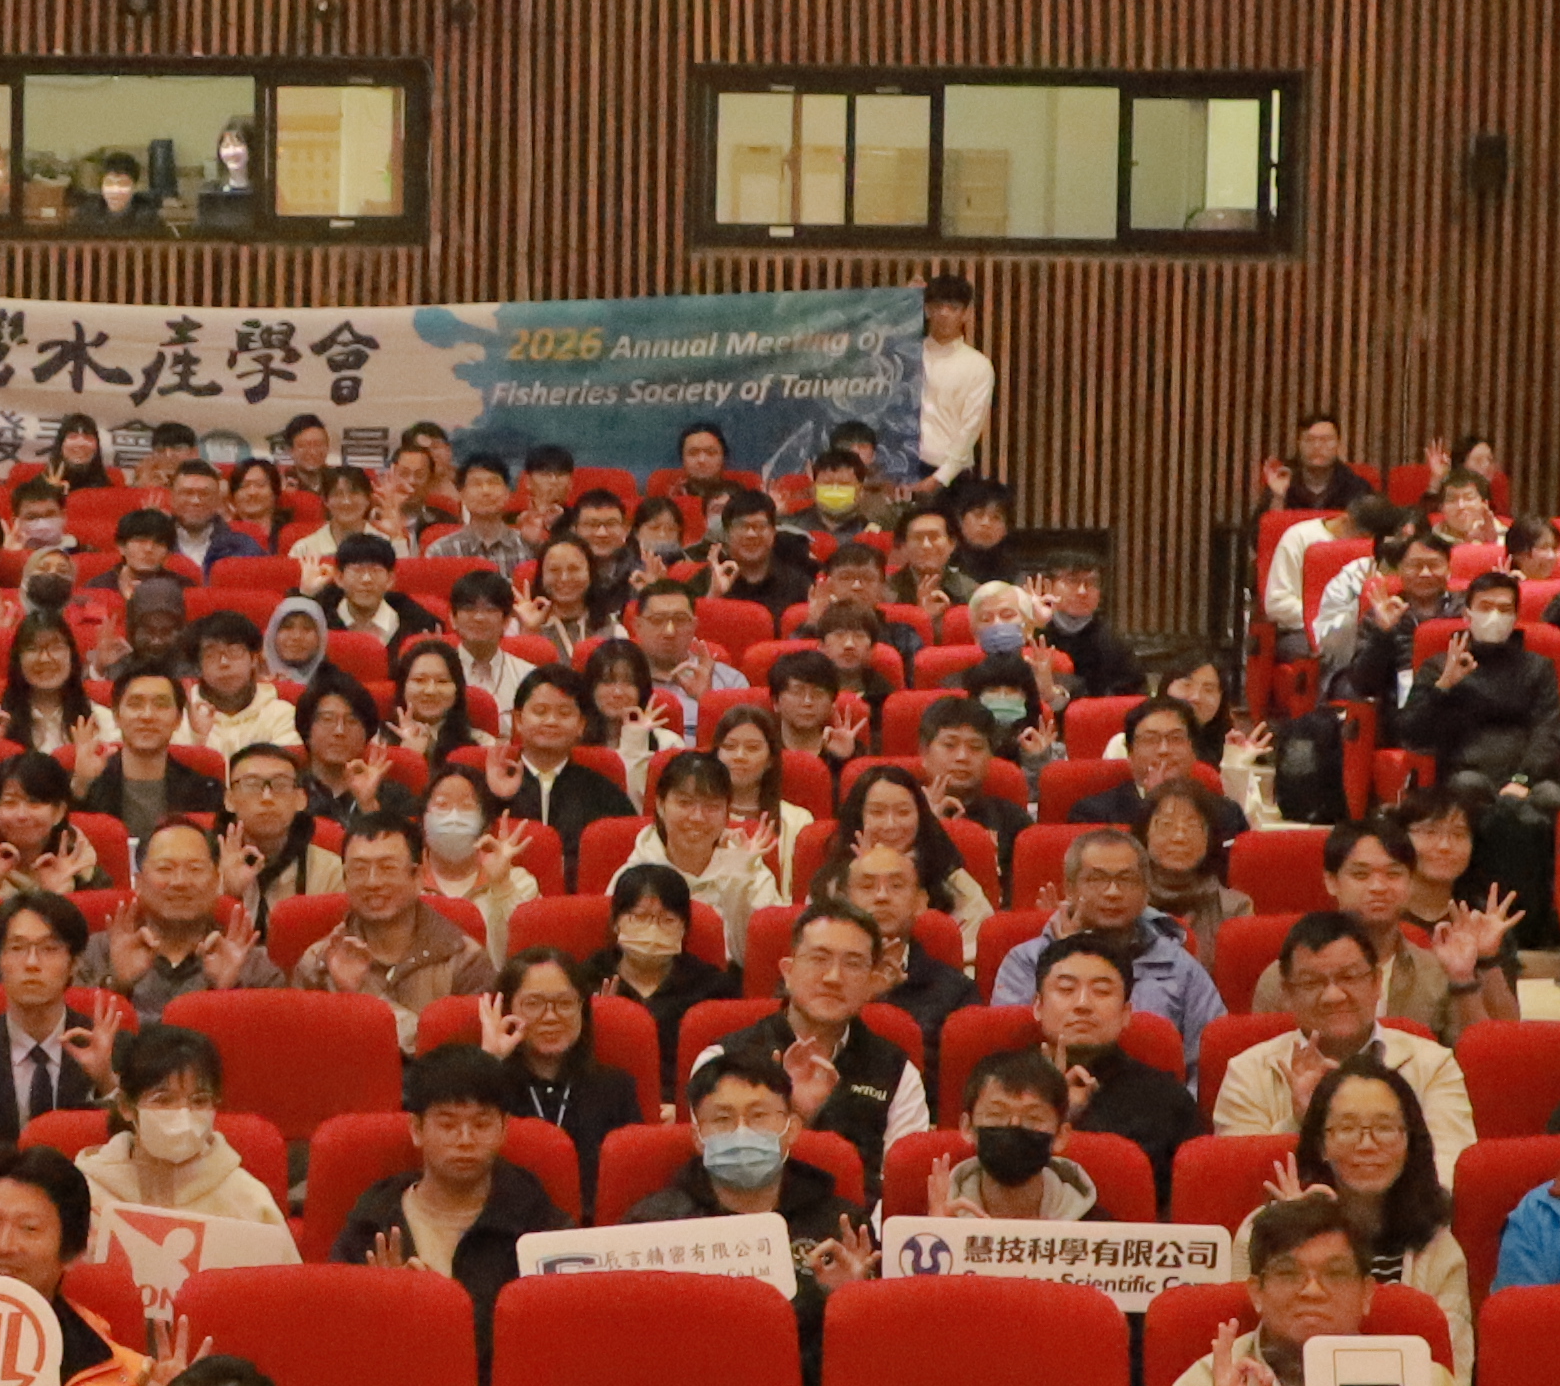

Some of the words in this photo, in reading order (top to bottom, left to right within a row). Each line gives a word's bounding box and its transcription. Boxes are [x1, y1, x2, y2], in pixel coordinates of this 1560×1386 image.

[506, 326, 604, 361] 2026
[610, 330, 719, 360] Annual
[725, 327, 848, 357] Meeting
[857, 325, 889, 353] of
[491, 379, 618, 407] Fisheries
[624, 376, 730, 407] Society
[740, 374, 775, 404] of
[781, 373, 894, 398] Taiwan
[963, 1235, 1219, 1270] 慧技科學有限公司
